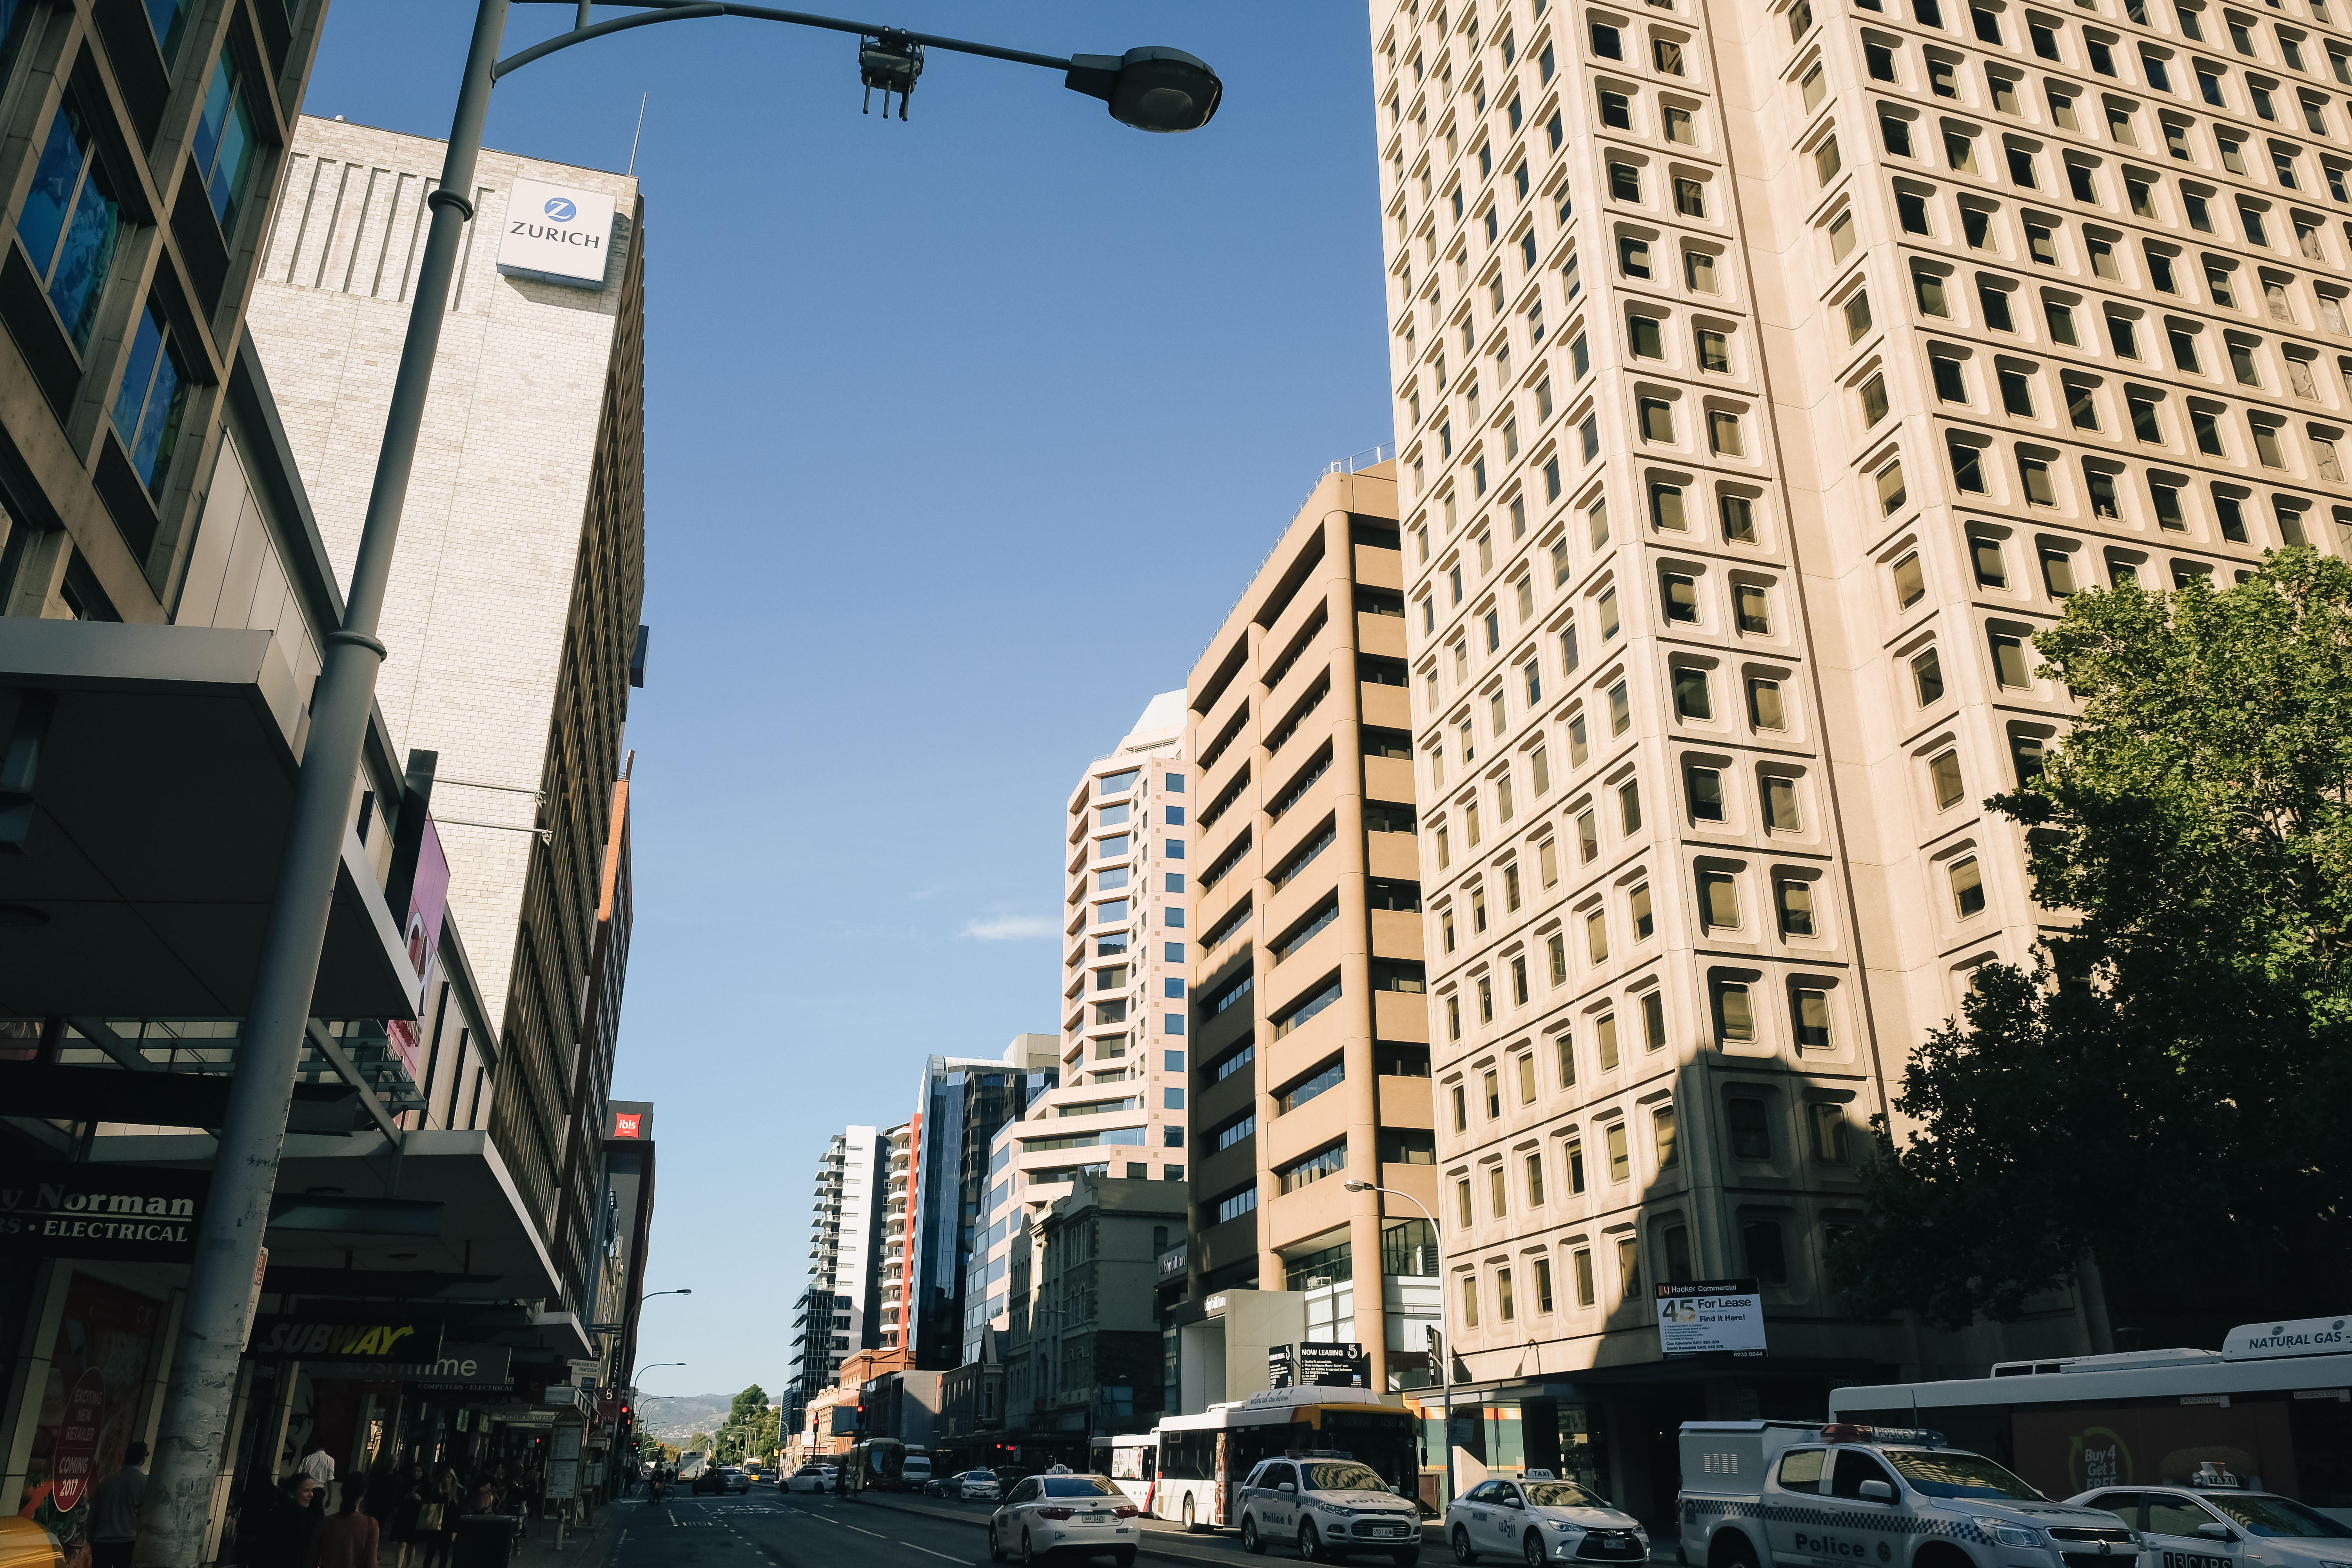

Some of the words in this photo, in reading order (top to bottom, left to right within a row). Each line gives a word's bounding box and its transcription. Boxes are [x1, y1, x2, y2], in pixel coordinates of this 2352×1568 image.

[510, 221, 600, 249] ZURICH
[619, 1119, 636, 1129] ibis
[34, 1183, 194, 1216] Norman
[43, 1220, 188, 1242] ELECTRICAL
[1164, 1255, 1185, 1274] bhpbilliton
[1662, 1299, 1695, 1322] 45
[1698, 1299, 1716, 1308] For
[1719, 1298, 1751, 1308] Lease
[256, 1323, 414, 1355] SUBWAY
[2249, 1334, 2310, 1349] NATURAL
[2314, 1332, 2341, 1344] GAS
[1347, 1344, 1357, 1359] 5
[74, 1389, 102, 1405] EXCITING
[76, 1408, 93, 1422] NEW
[65, 1426, 95, 1441] RETAILER
[1877, 1429, 1909, 1438] POLICE
[2085, 1448, 2106, 1463] Buy
[2107, 1444, 2116, 1460] 4
[59, 1456, 89, 1474] COMING
[2087, 1463, 2107, 1477] Get
[2110, 1461, 2116, 1475] 1
[60, 1479, 79, 1496] 2017
[2087, 1477, 2117, 1490] FREE
[2210, 1475, 2235, 1485] TAXI
[1263, 1512, 1284, 1524] Police
[1685, 1507, 1696, 1518] 000
[2020, 1508, 2118, 1519] Police
[1795, 1533, 1865, 1557] Police
[2164, 1552, 2232, 1568] 13CABS
